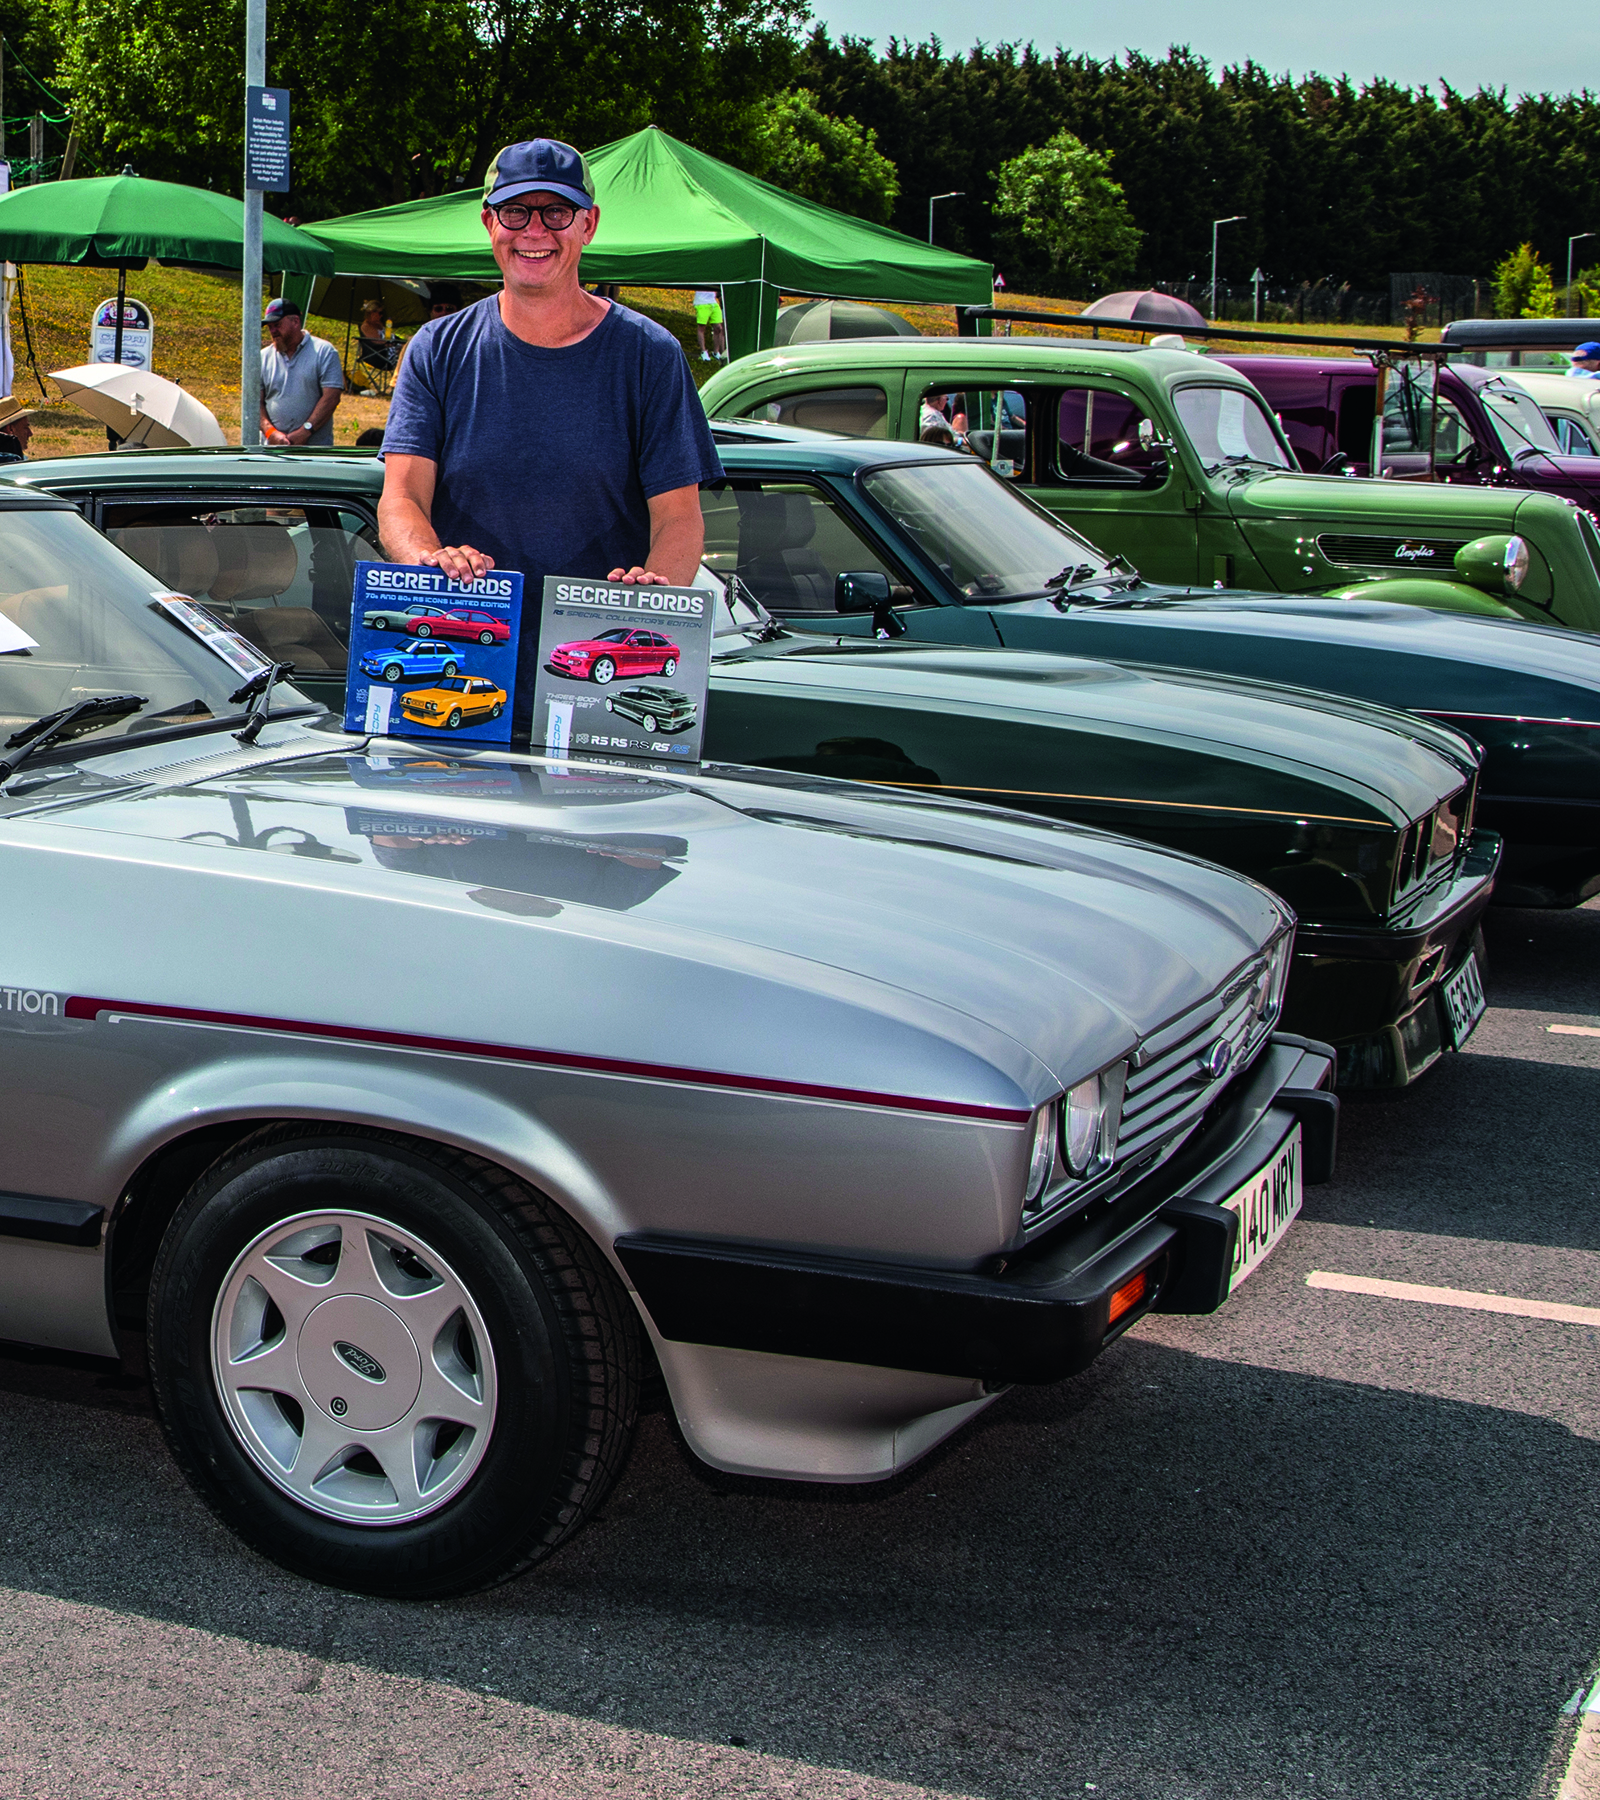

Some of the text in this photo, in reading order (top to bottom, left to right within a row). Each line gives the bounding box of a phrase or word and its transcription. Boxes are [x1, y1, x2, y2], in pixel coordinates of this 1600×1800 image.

[1394, 545, 1436, 561] Anglia
[366, 569, 513, 597] SECRET FORDS
[425, 597, 448, 605] ICONS
[449, 598, 480, 607] LIMITED
[480, 601, 511, 609] EDITION
[556, 584, 704, 614] SECRET FORDS
[566, 610, 603, 620] SPECIAL
[605, 614, 665, 625] COLLECTOR'S
[666, 619, 703, 629] EDITION
[546, 692, 602, 704] THREE-BOOK
[576, 700, 595, 709] SET
[591, 735, 609, 745] RS
[610, 736, 628, 748] RS
[629, 740, 650, 750] RS
[651, 742, 671, 752] RS
[669, 744, 691, 755] RS
[1272, 1142, 1296, 1234] MRY
[346, 1347, 377, 1375] Ford
